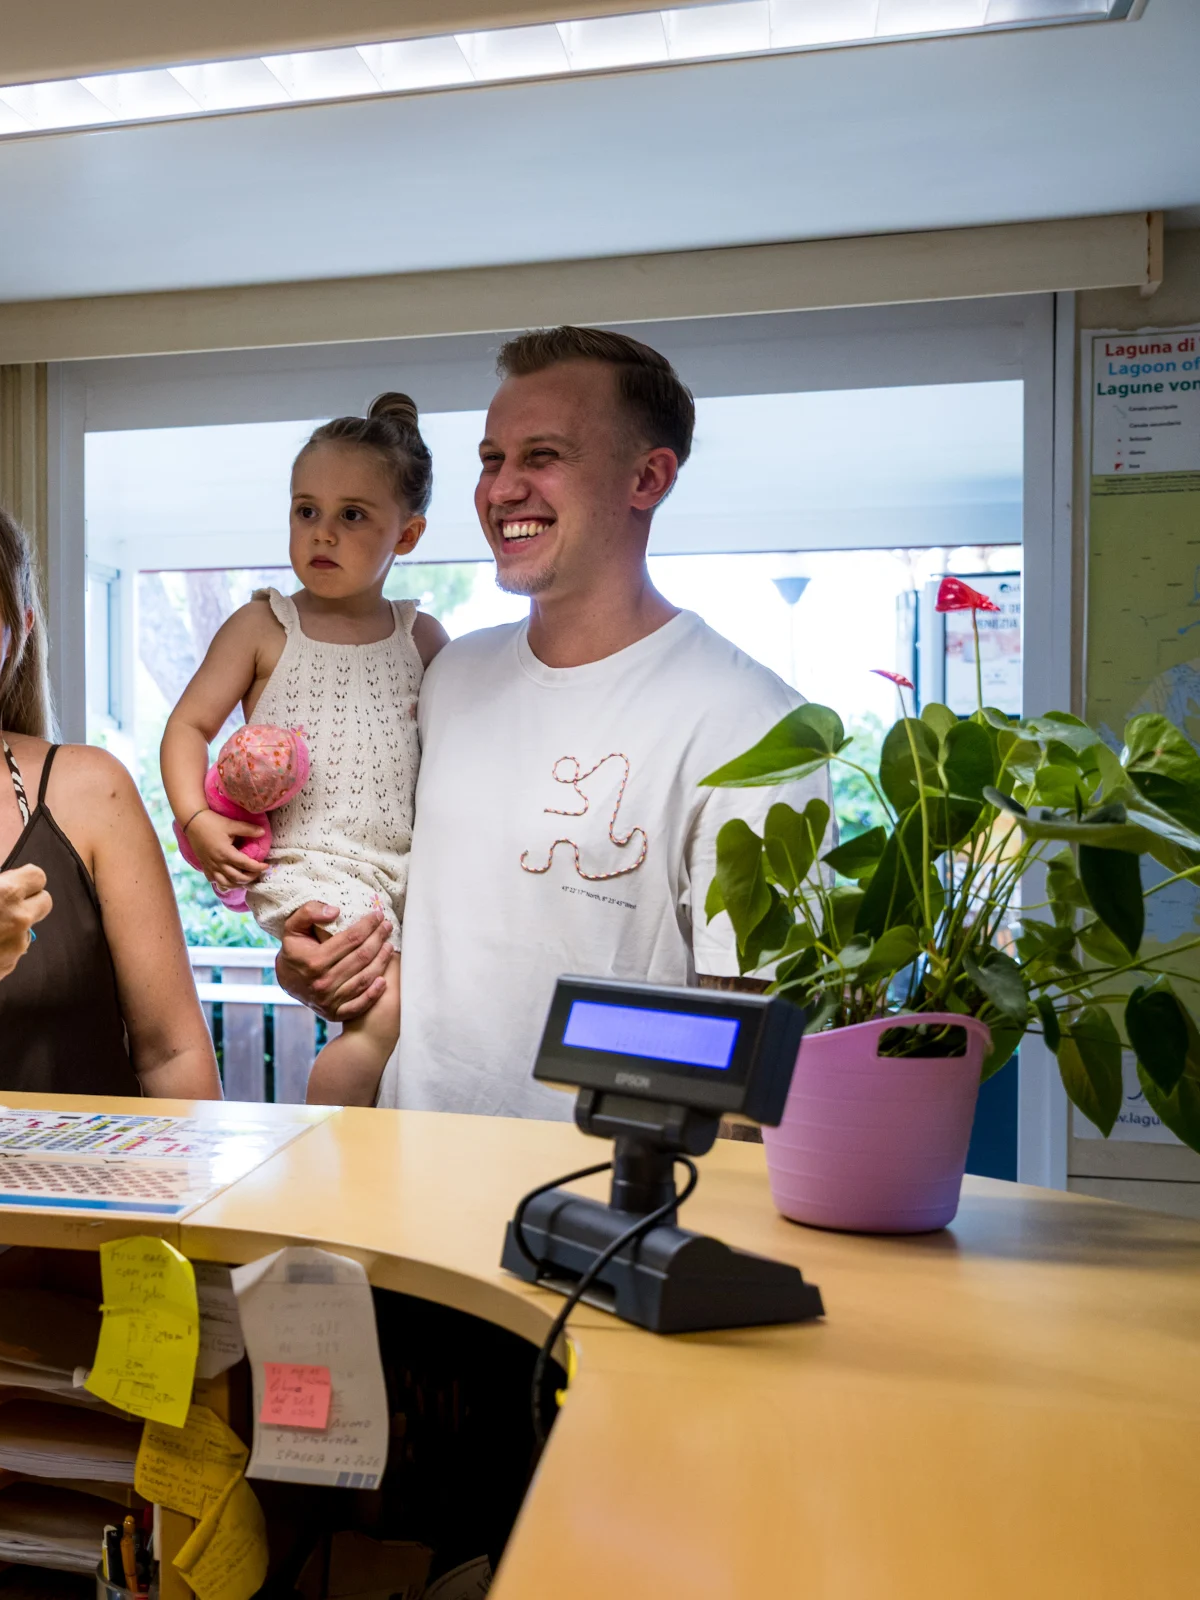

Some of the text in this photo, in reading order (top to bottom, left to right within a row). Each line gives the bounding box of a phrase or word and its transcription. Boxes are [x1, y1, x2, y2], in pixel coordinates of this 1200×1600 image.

[1105, 337, 1195, 359] Laguna di
[1108, 356, 1200, 378] Lagoon of
[1096, 381, 1164, 398] Lagune
